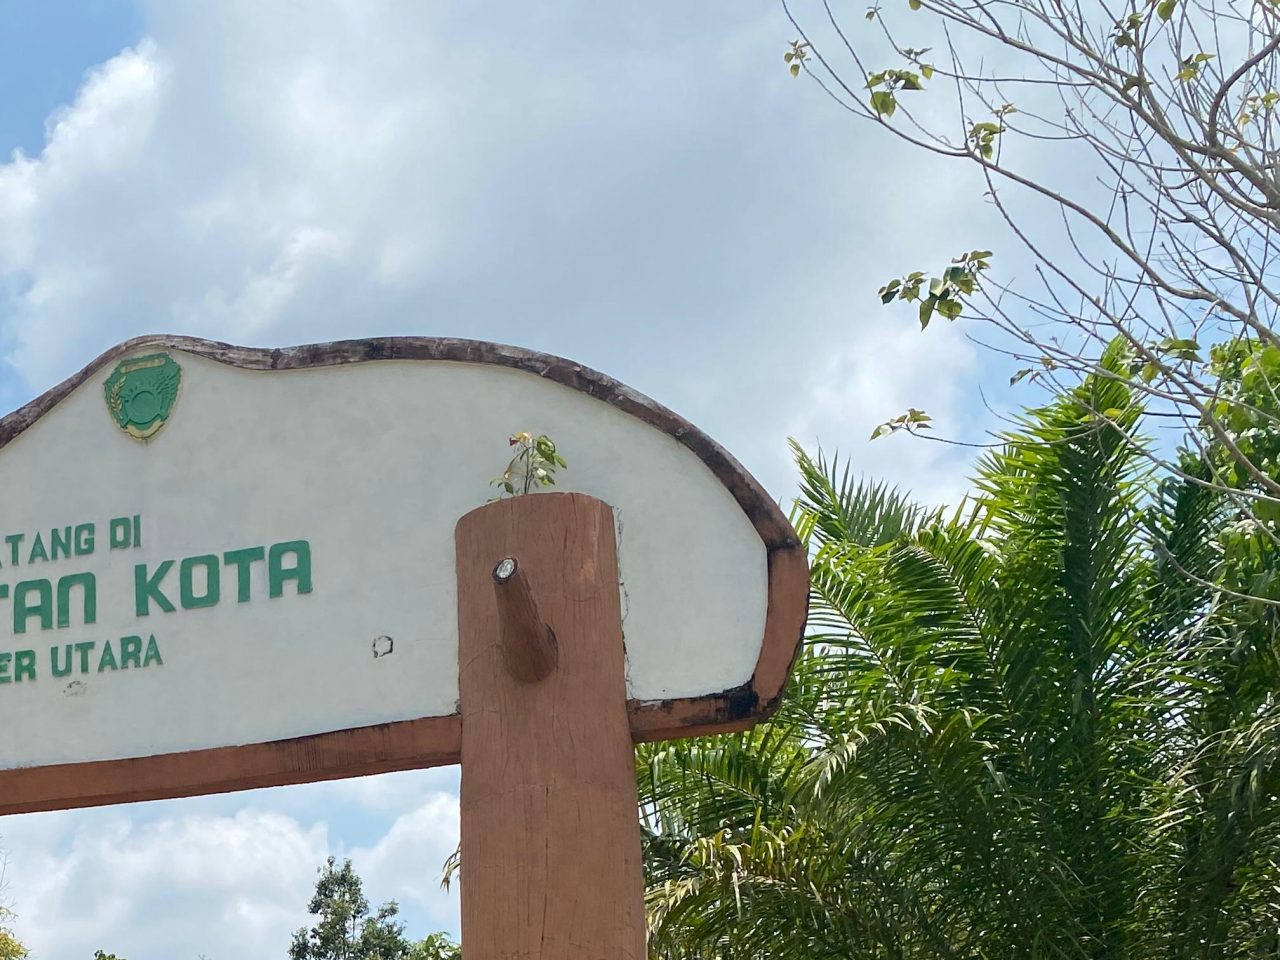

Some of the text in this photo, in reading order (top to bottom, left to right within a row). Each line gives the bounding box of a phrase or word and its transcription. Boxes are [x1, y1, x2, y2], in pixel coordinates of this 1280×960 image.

[109, 515, 142, 549] DI
[135, 540, 312, 616] KOTA
[51, 634, 163, 677] UTARA
